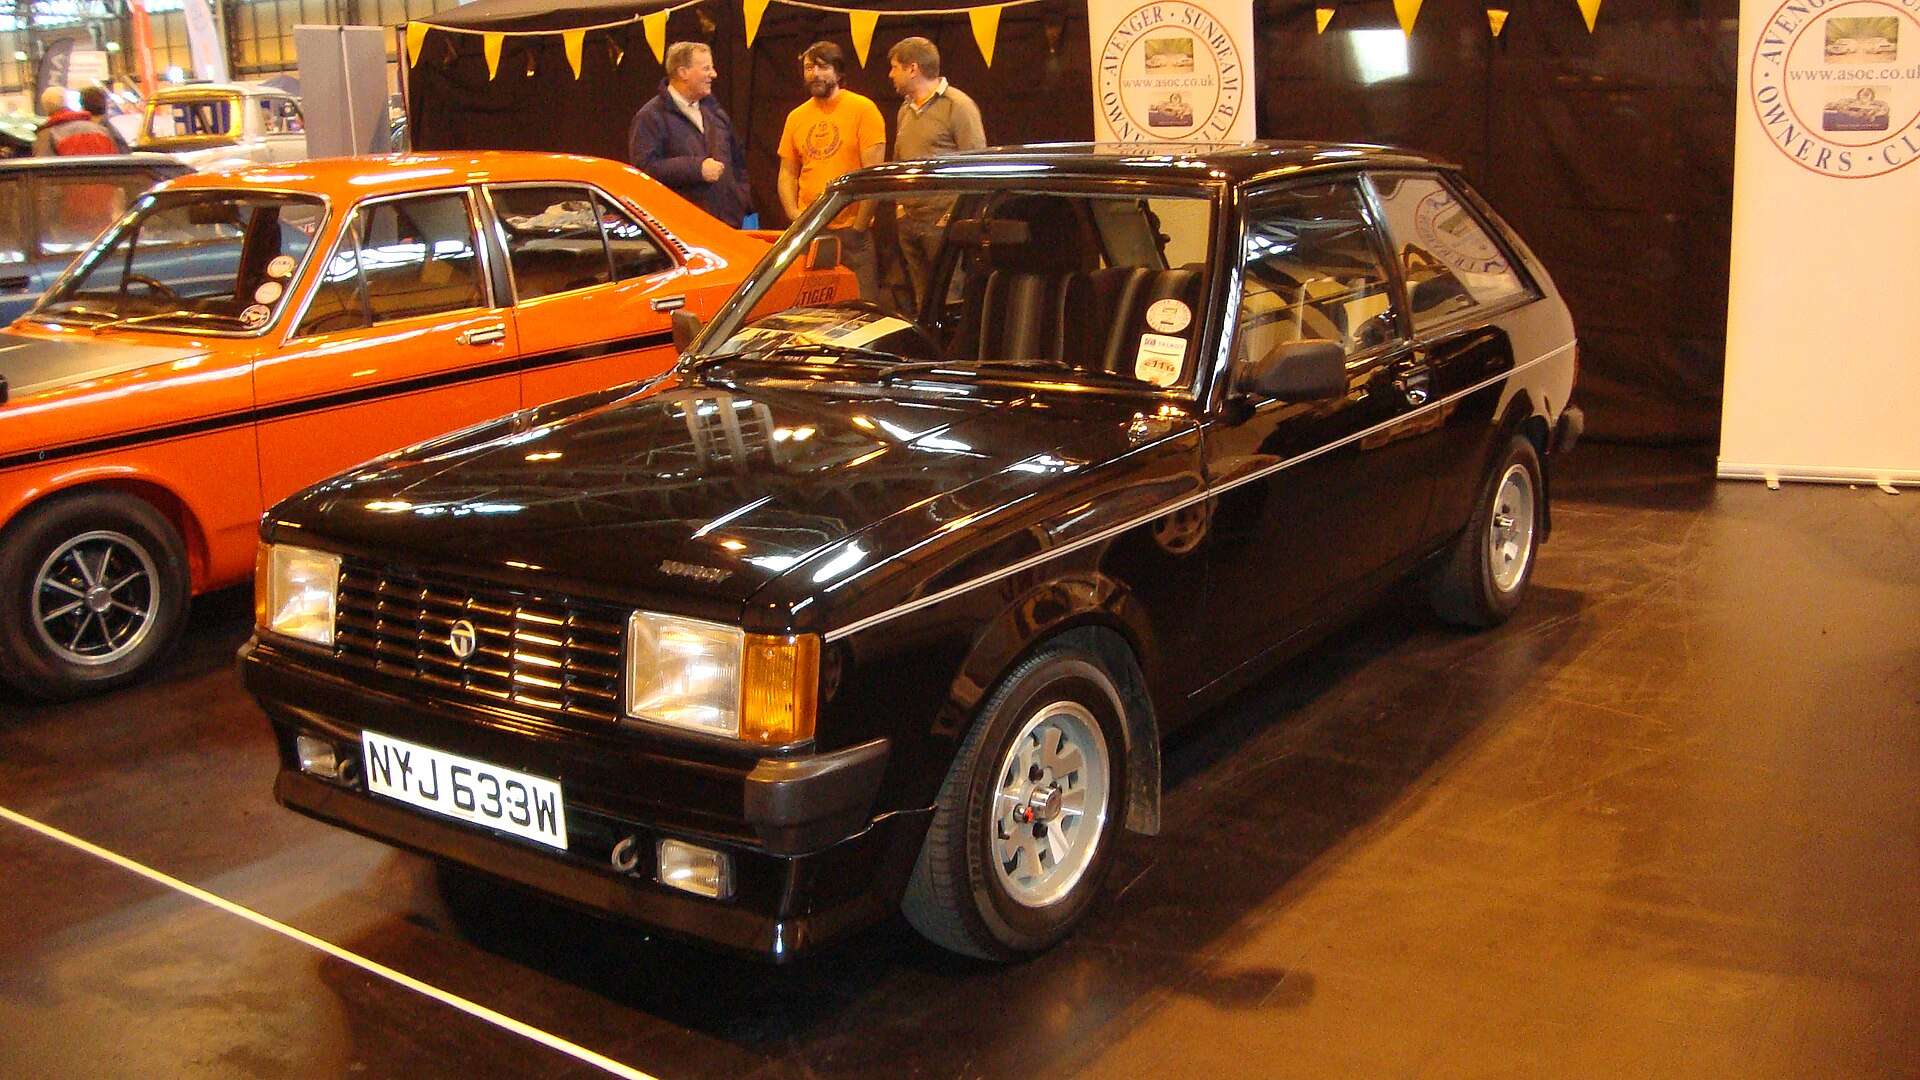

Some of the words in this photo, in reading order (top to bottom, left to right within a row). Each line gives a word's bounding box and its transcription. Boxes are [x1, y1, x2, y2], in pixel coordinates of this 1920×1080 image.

[1103, 5, 1164, 77] AVENGER
[1181, 6, 1238, 91] SUNBEAM
[1761, 0, 1825, 66] AVEN
[1121, 75, 1216, 89] www.asoc.co.uk
[1757, 85, 1852, 172] OWNERS
[801, 286, 835, 305] TIGER
[369, 740, 439, 801] NYJ
[450, 765, 558, 836] 633W
